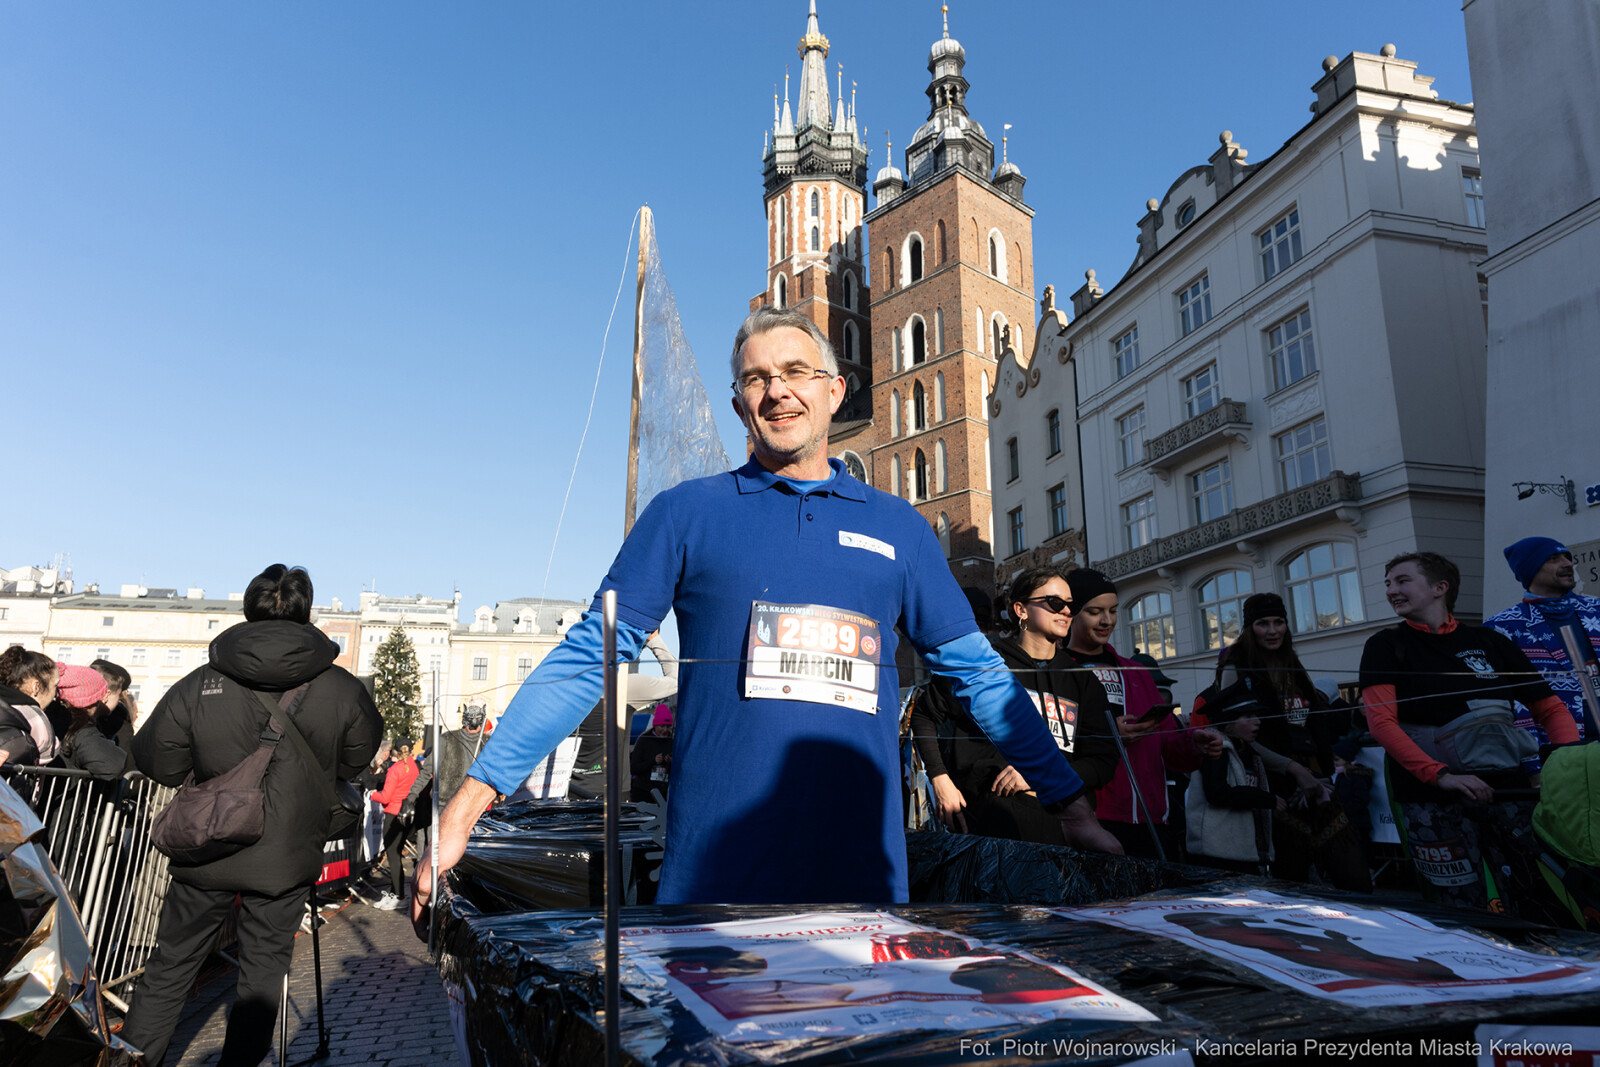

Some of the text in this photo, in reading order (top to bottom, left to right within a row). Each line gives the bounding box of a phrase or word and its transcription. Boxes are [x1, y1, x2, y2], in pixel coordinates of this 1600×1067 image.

[769, 606, 814, 616] KRAKOWSKI
[780, 616, 856, 654] 2589
[779, 651, 853, 682] MARCIN
[1415, 845, 1454, 861] 3795
